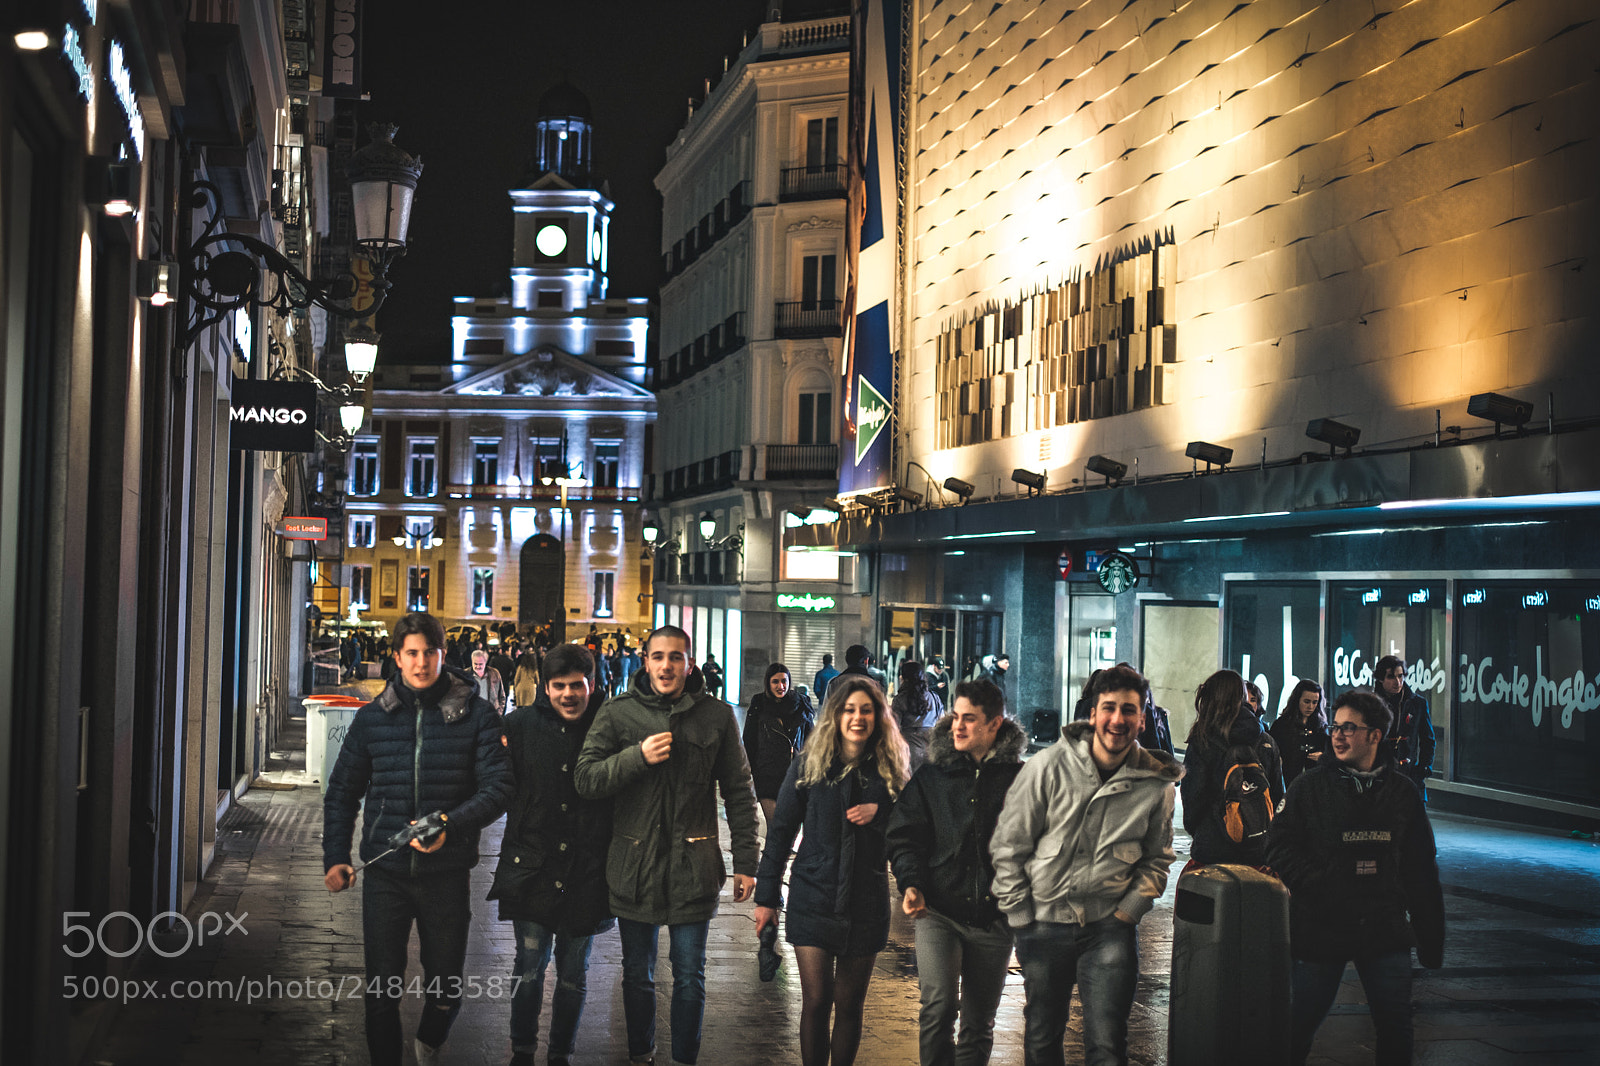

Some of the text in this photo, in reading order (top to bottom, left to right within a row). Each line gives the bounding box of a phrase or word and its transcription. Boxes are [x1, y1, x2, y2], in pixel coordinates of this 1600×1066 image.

[230, 406, 307, 424] MANGO
[1334, 647, 1349, 687] El
[1477, 656, 1529, 707] Corte
